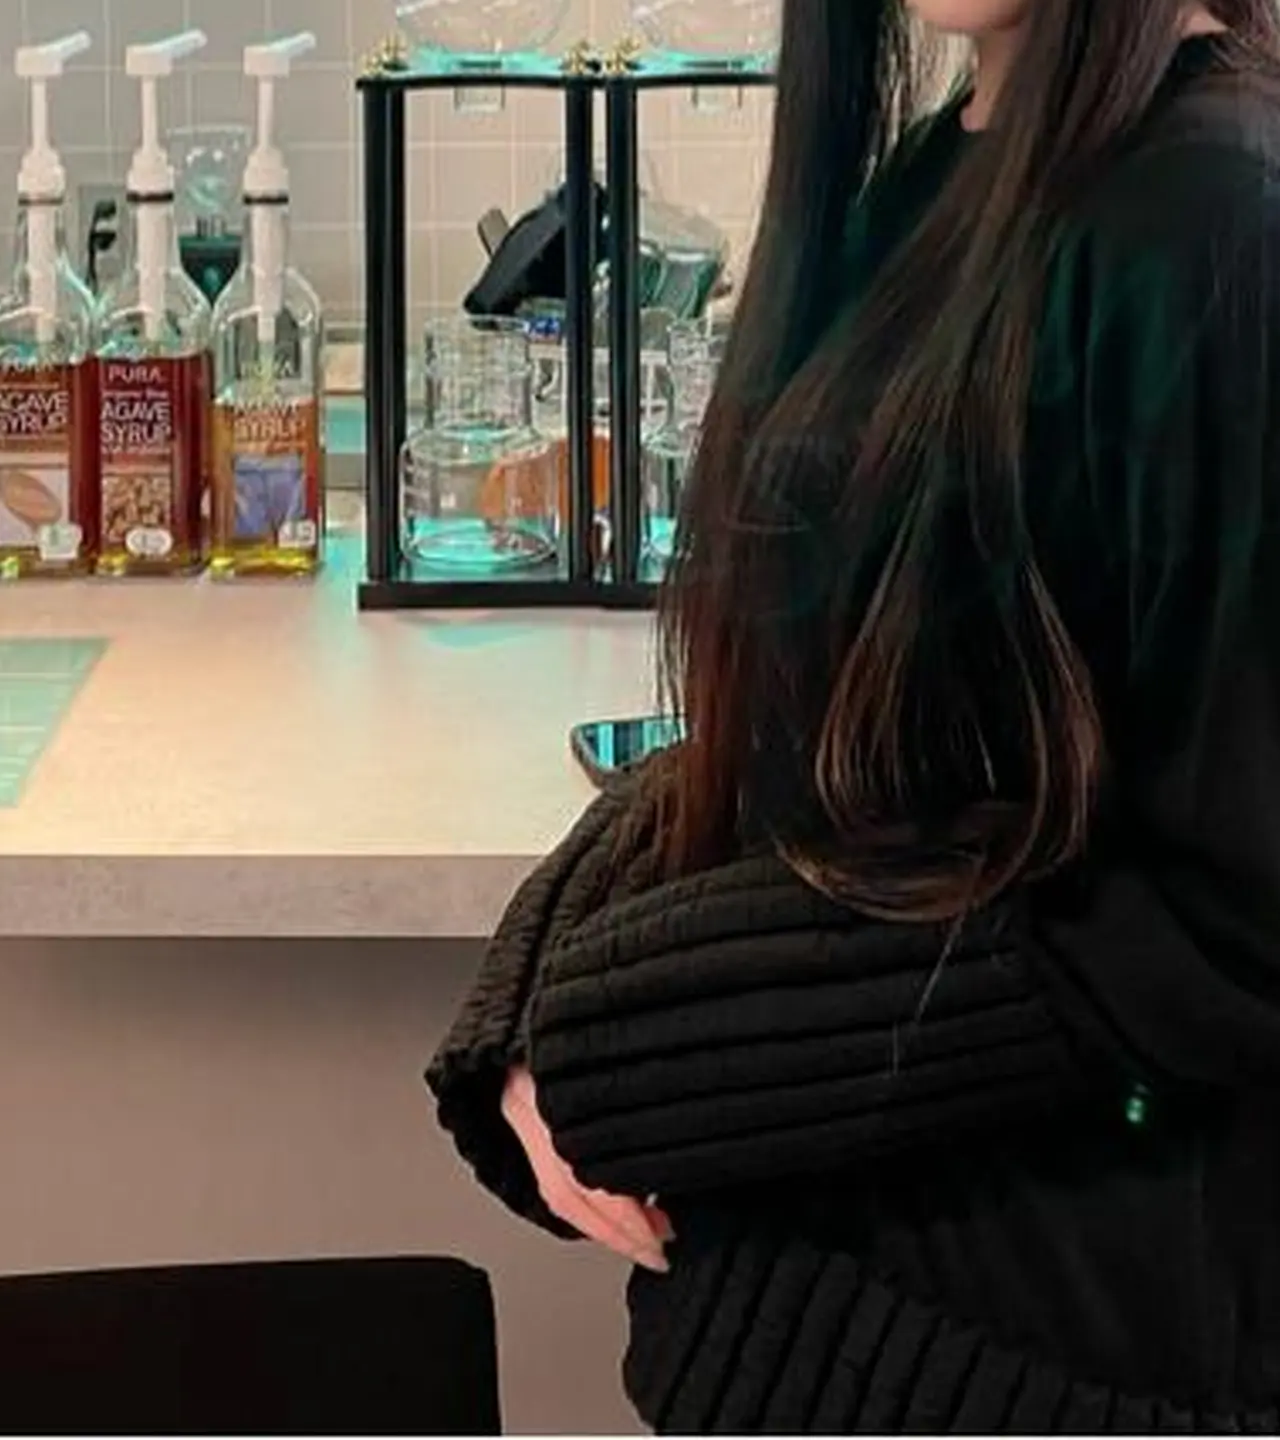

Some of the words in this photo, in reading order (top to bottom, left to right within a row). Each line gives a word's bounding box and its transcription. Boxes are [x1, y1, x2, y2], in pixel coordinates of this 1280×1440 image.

[108, 365, 162, 384] PURA
[100, 401, 170, 422] AGAVE
[100, 421, 172, 445] SYRUP
